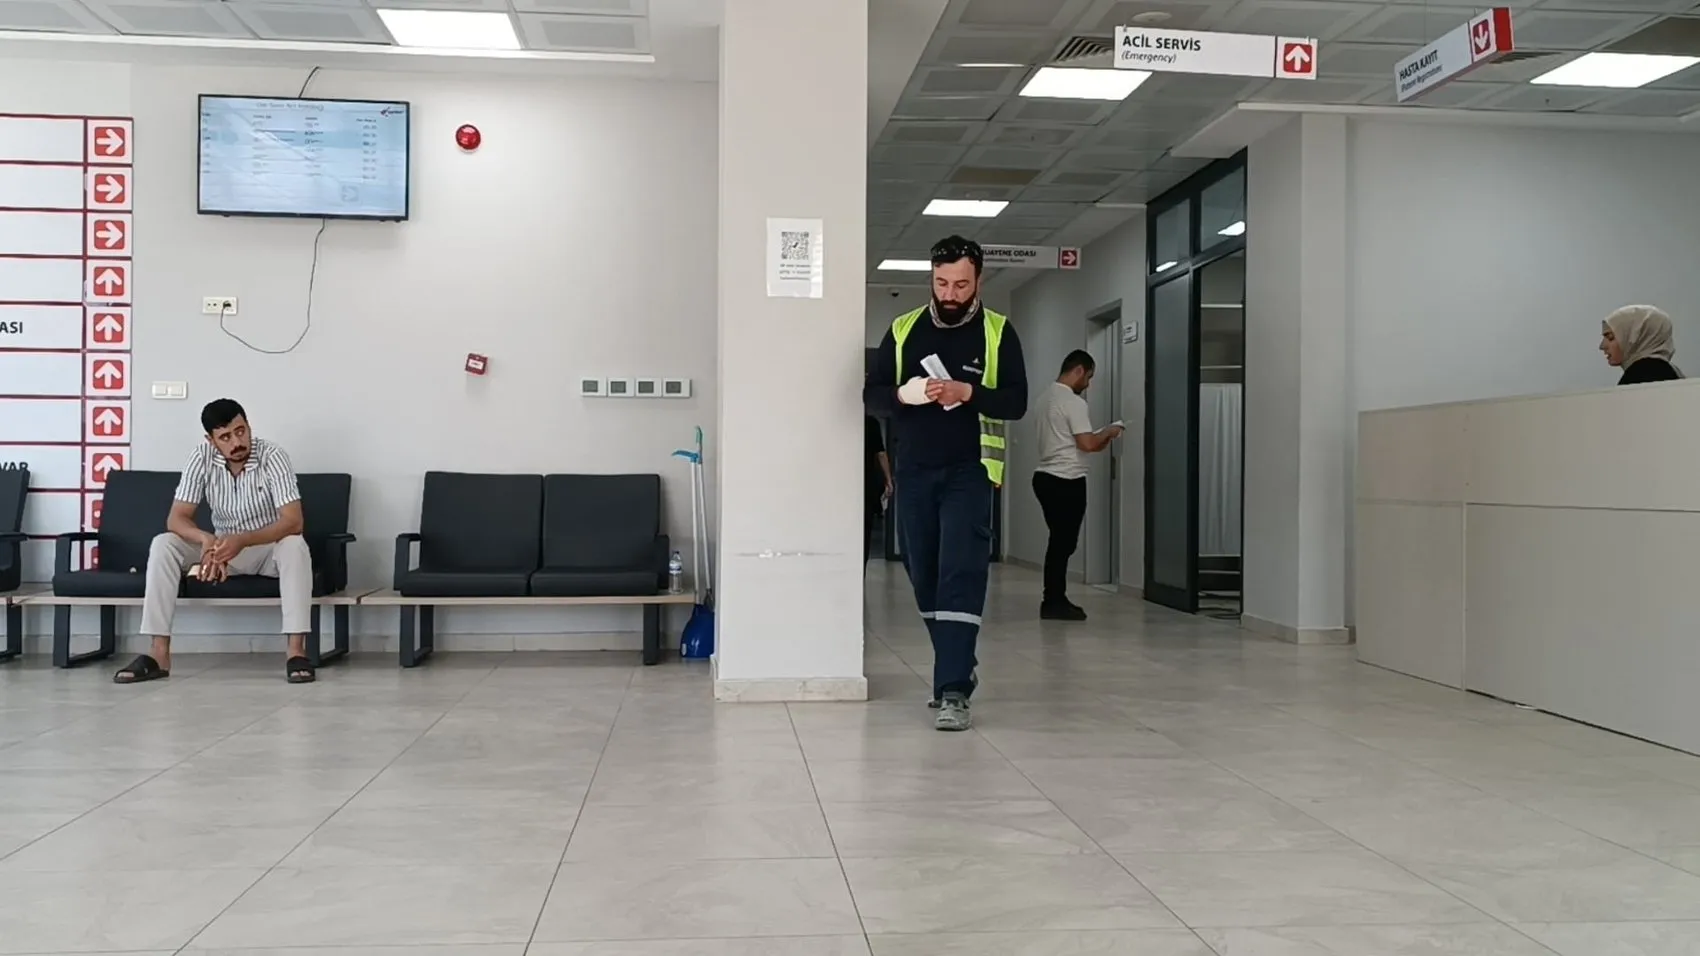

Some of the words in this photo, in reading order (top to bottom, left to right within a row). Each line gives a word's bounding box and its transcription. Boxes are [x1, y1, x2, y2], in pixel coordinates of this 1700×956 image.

[1122, 33, 1152, 48] ACİL
[1155, 37, 1201, 51] SERVİS
[1121, 50, 1177, 64] (Emergency)
[1399, 61, 1420, 81] HASTA
[1420, 49, 1438, 68] KAYIT
[982, 249, 1012, 257] UAYENE
[0, 321, 23, 334] ASI
